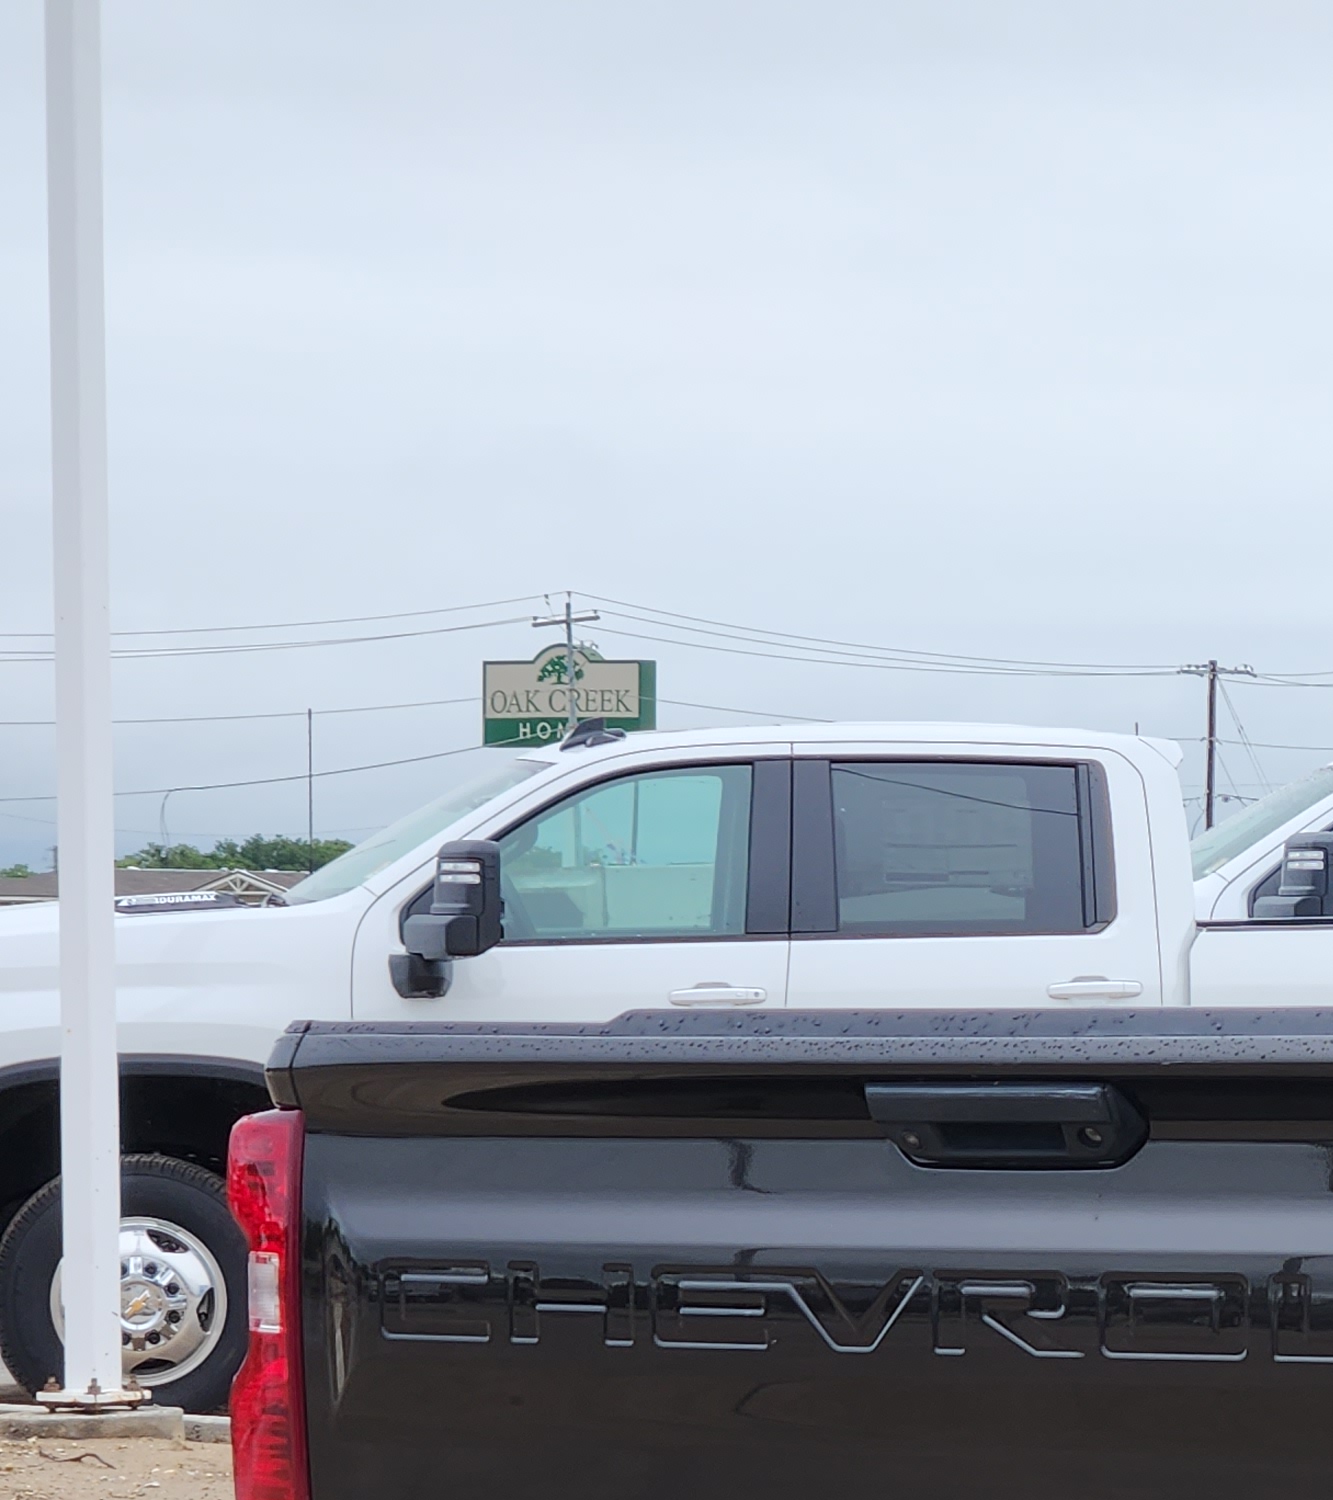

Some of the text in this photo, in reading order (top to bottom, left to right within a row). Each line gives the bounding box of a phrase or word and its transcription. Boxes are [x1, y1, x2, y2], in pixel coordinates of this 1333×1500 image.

[490, 688, 633, 714] OAK CREEK
[158, 893, 217, 904] DURAMAX
